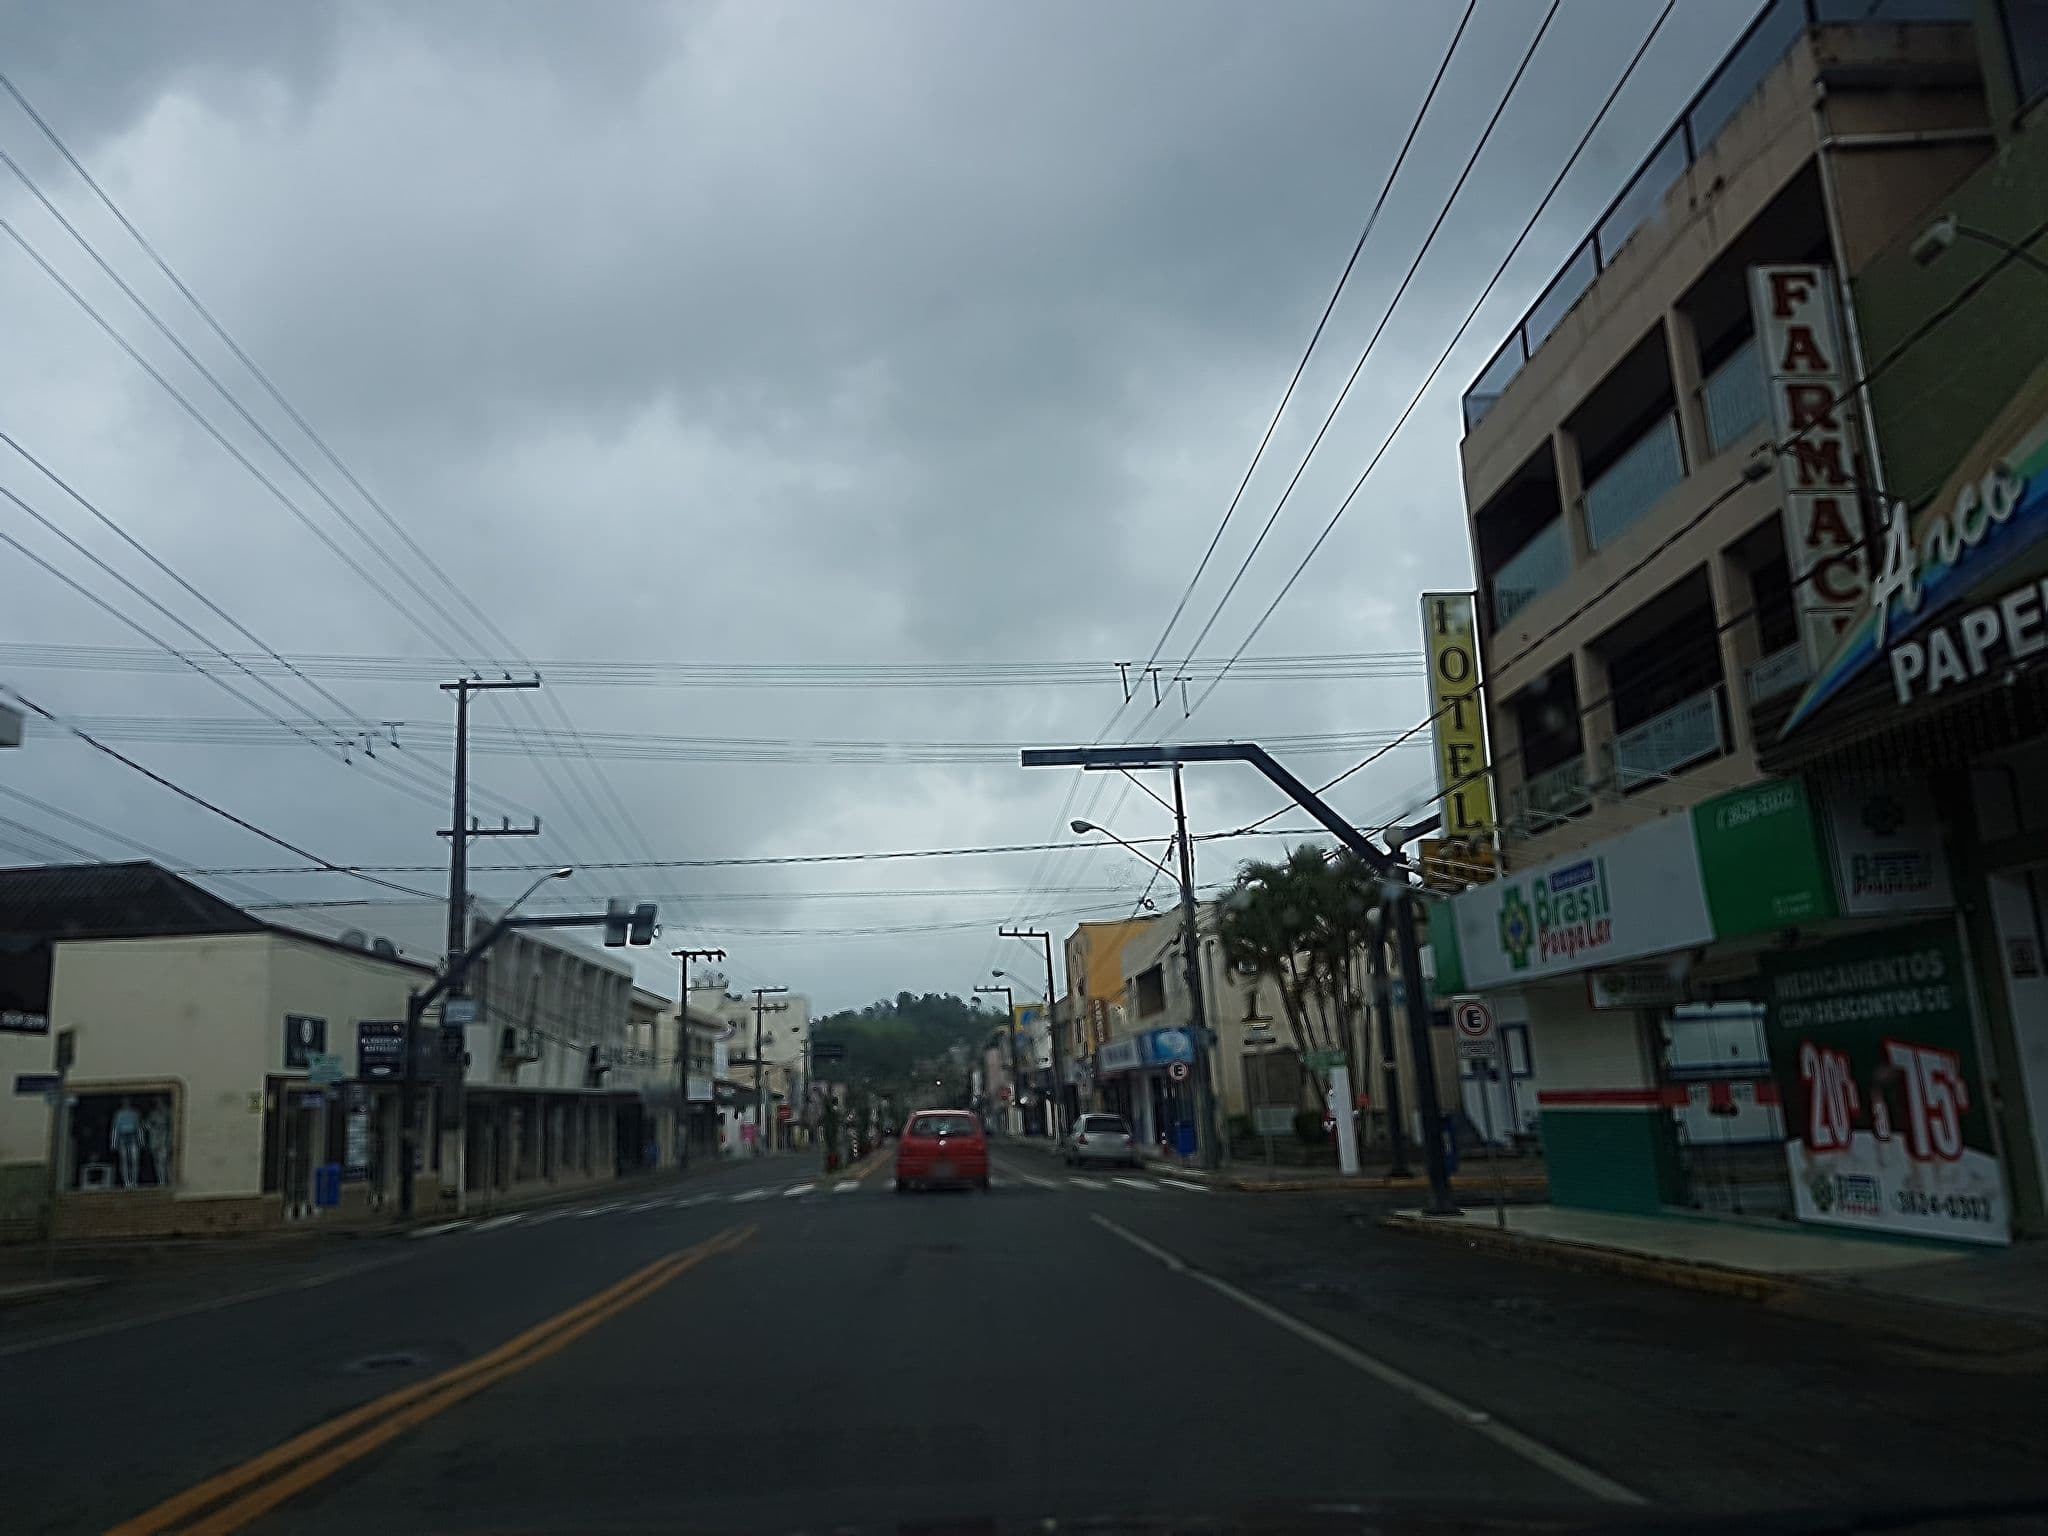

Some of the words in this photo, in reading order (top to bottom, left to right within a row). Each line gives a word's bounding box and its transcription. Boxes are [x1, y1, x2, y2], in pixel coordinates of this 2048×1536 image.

[1770, 273, 1862, 636] FARMAC
[1889, 577, 2048, 705] PAPE
[1535, 856, 1609, 928] Brasil
[1466, 1009, 1482, 1028] E
